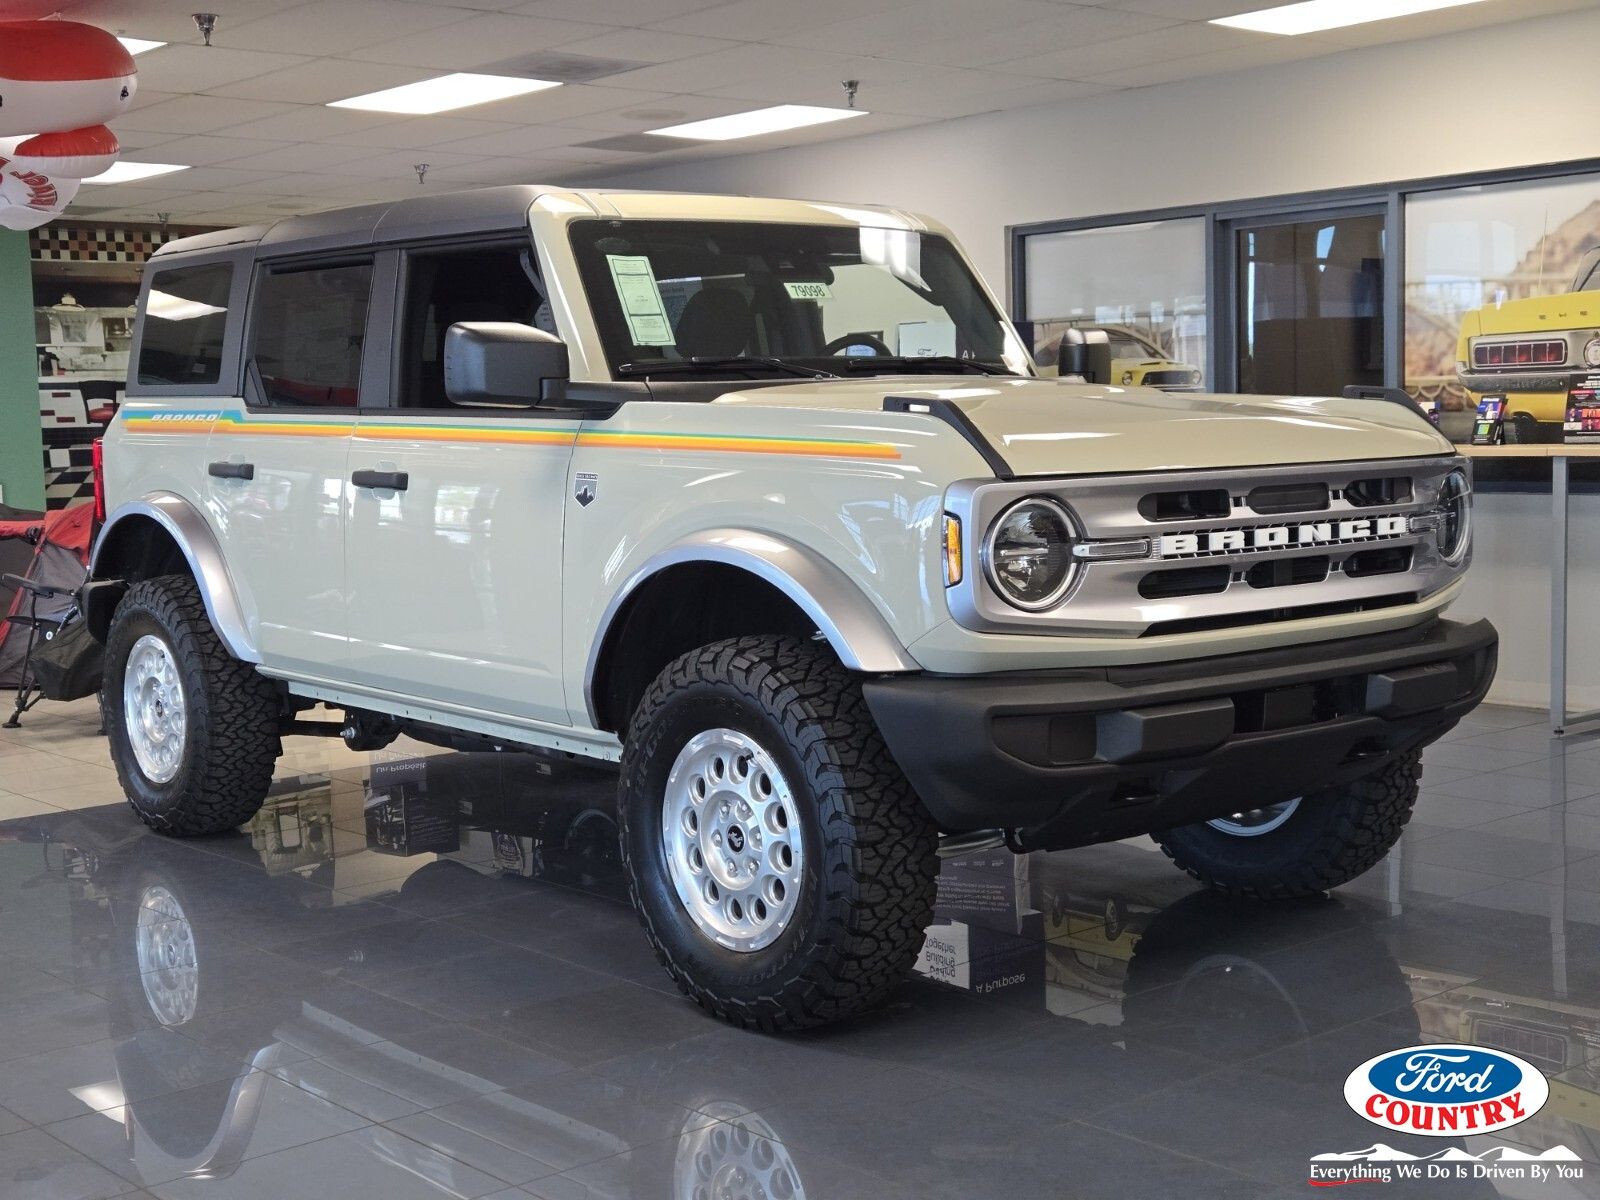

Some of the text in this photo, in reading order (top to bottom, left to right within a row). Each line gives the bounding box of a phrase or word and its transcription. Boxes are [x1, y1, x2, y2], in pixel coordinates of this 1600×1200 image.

[791, 285, 826, 297] 79098
[153, 413, 218, 422] BRONCO
[1160, 516, 1407, 555] BRONCO
